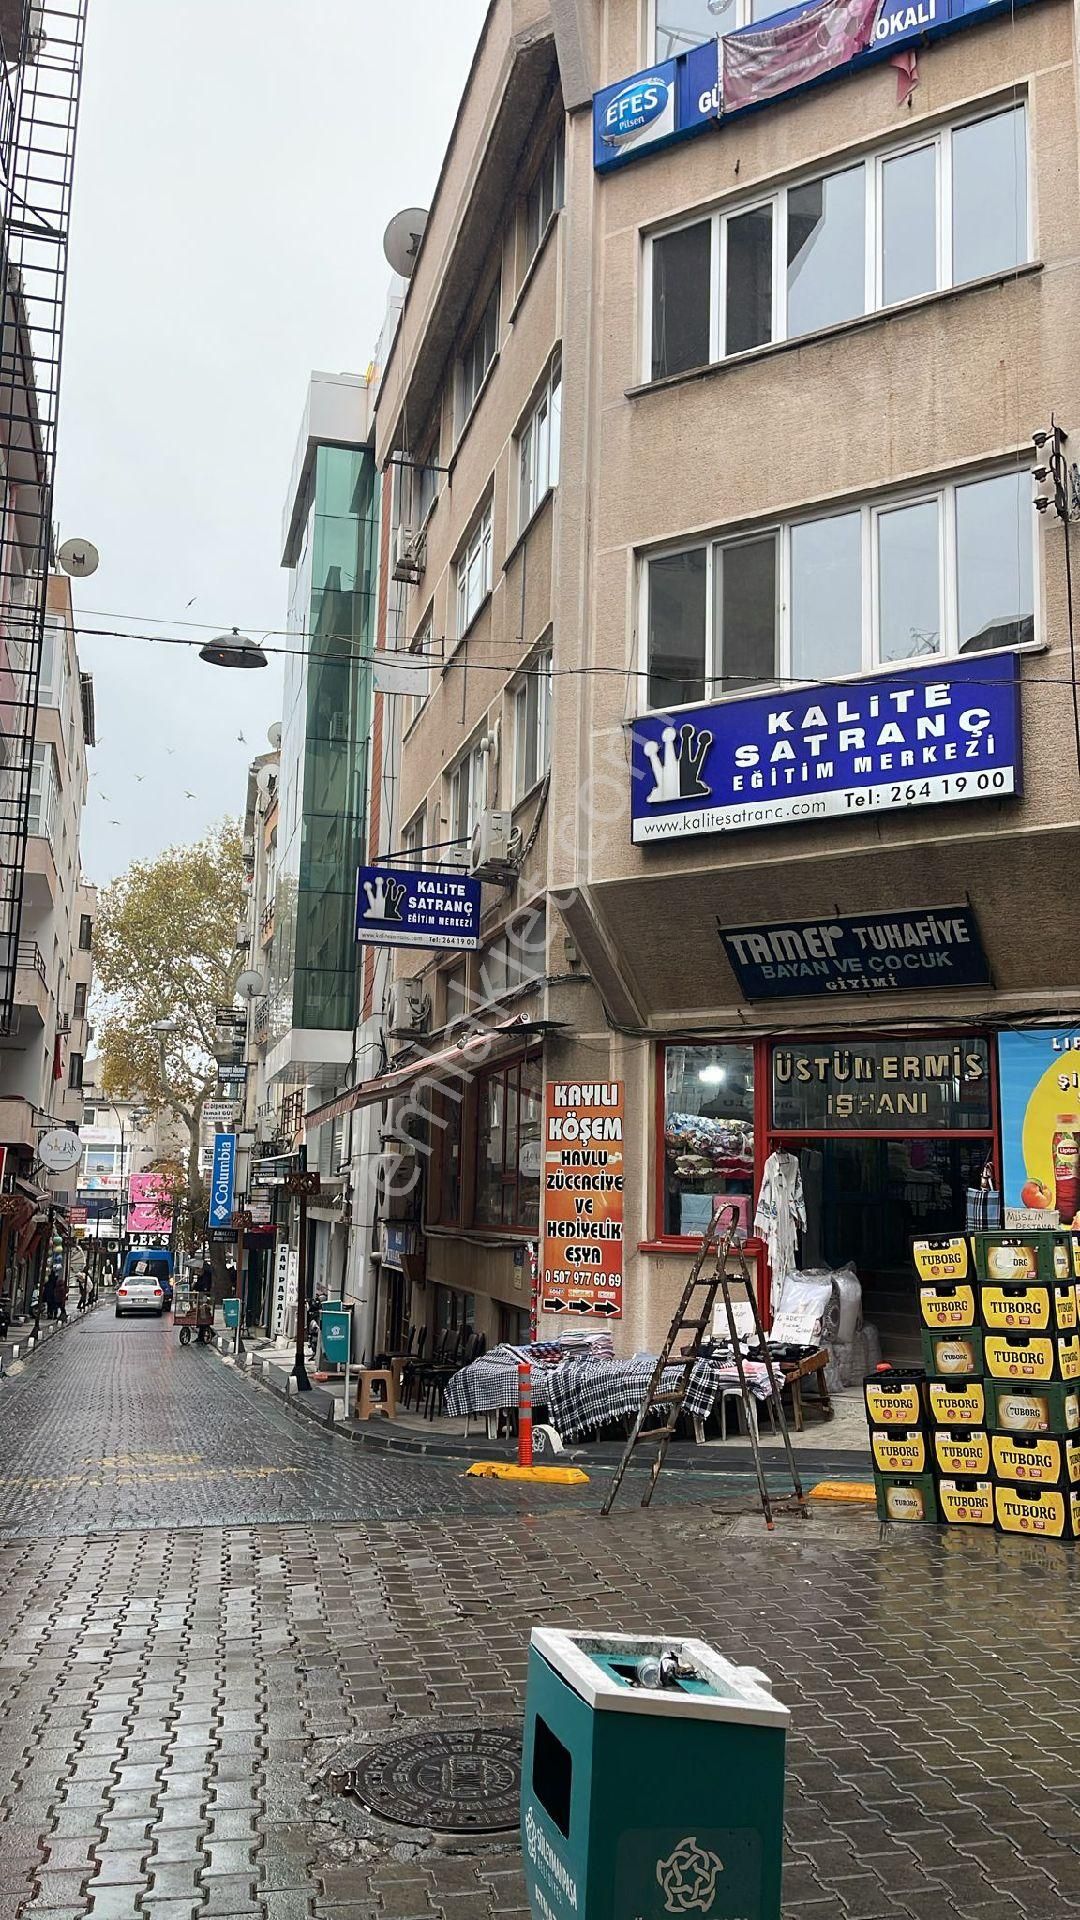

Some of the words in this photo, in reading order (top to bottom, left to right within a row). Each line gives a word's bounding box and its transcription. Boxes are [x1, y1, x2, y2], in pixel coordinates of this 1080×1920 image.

[872, 0, 936, 39] OKALI
[606, 88, 657, 126] EFES
[620, 115, 645, 130] Pilsen
[735, 708, 991, 768] SATRANÇ
[733, 762, 833, 792] EĞİTİM
[854, 734, 994, 773] MERKEZİ
[845, 788, 880, 808] Tel:
[891, 781, 931, 803] 264
[942, 776, 967, 795] 19
[977, 771, 1004, 790] 00
[408, 896, 473, 916] SATRANÇ
[407, 914, 435, 924] EĞİTİM
[852, 915, 970, 951] TUHAFİYE
[761, 960, 830, 980] BAYAN
[833, 957, 863, 973] VE
[868, 951, 953, 973] ÇOCUK
[825, 973, 898, 991] GİYİMİ
[554, 1084, 618, 1106] KAYILI
[549, 1111, 622, 1147] KÖŞEM
[561, 1150, 608, 1166] HAVLU
[214, 1141, 232, 1205] Columbia
[546, 1169, 623, 1191] ZÜCCACİYE
[575, 1198, 593, 1214] VE
[547, 1216, 621, 1240] HEDİYELİK
[279, 1246, 287, 1271] CAN
[565, 1246, 601, 1266] EŞYA
[921, 1253, 962, 1266] TUBORG
[545, 1270, 550, 1283] 0
[553, 1270, 570, 1283] 507
[574, 1271, 592, 1285] 977
[594, 1272, 607, 1286] 60
[608, 1273, 621, 1287] 69
[927, 1301, 968, 1313] TUBORG
[991, 1302, 1041, 1314] TUBORG
[994, 1351, 1045, 1365] TUBORG
[874, 1399, 913, 1409] TUBORG
[937, 1399, 979, 1409] TUBORG
[1009, 1407, 1041, 1418] TUBORG
[879, 1446, 919, 1457] TUBORG
[942, 1447, 983, 1458] TUBORG
[1000, 1451, 1052, 1468] TUBORG
[947, 1495, 989, 1508] TUBORG
[1004, 1502, 1057, 1521] TUBORG
